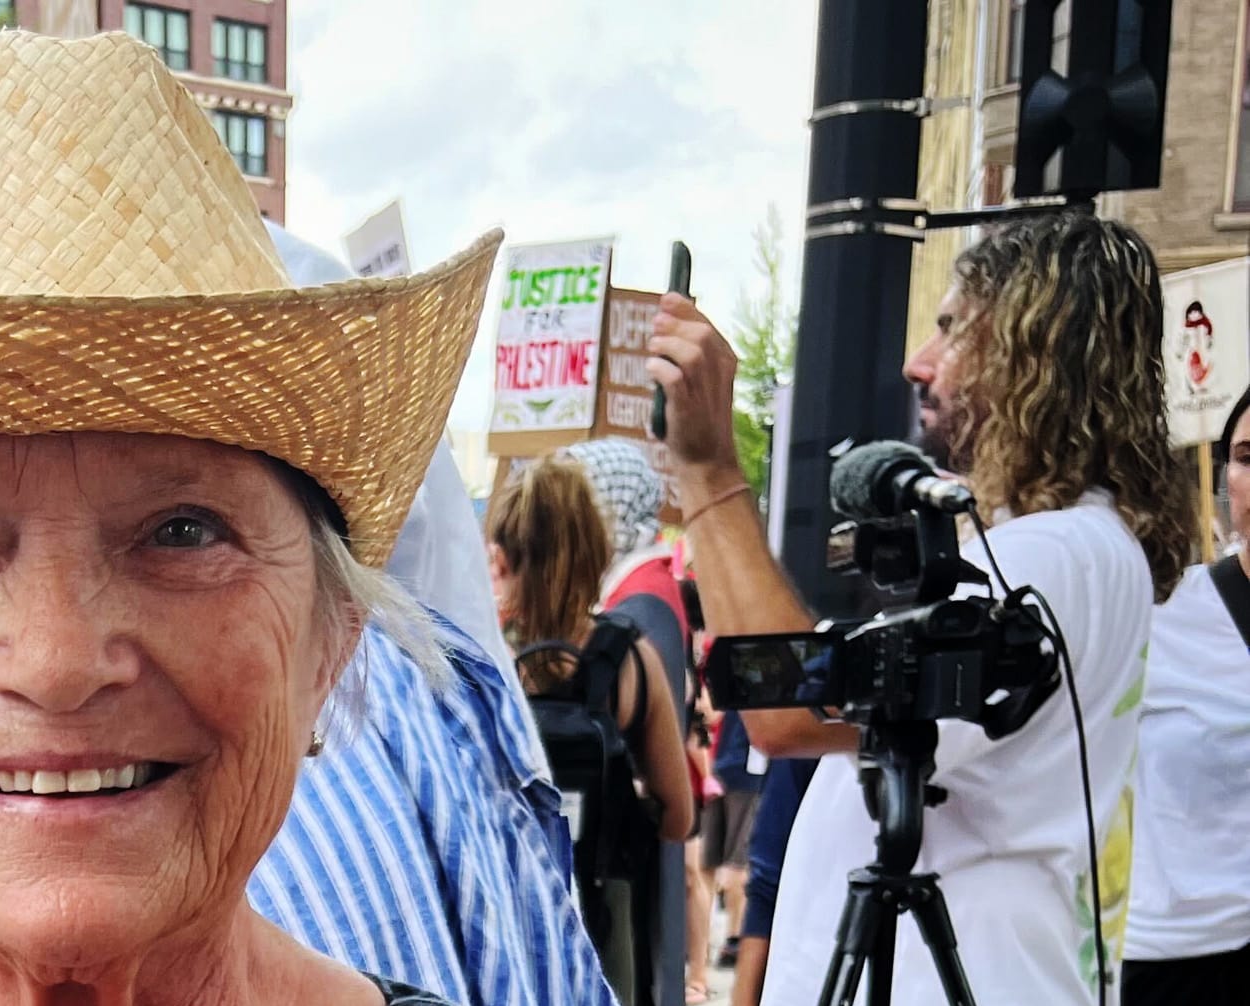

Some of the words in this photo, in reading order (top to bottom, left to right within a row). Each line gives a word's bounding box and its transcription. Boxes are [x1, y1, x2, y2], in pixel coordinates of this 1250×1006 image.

[502, 265, 601, 310] JUSTICE
[524, 310, 565, 333] FOR
[495, 340, 597, 391] PALESTINE
